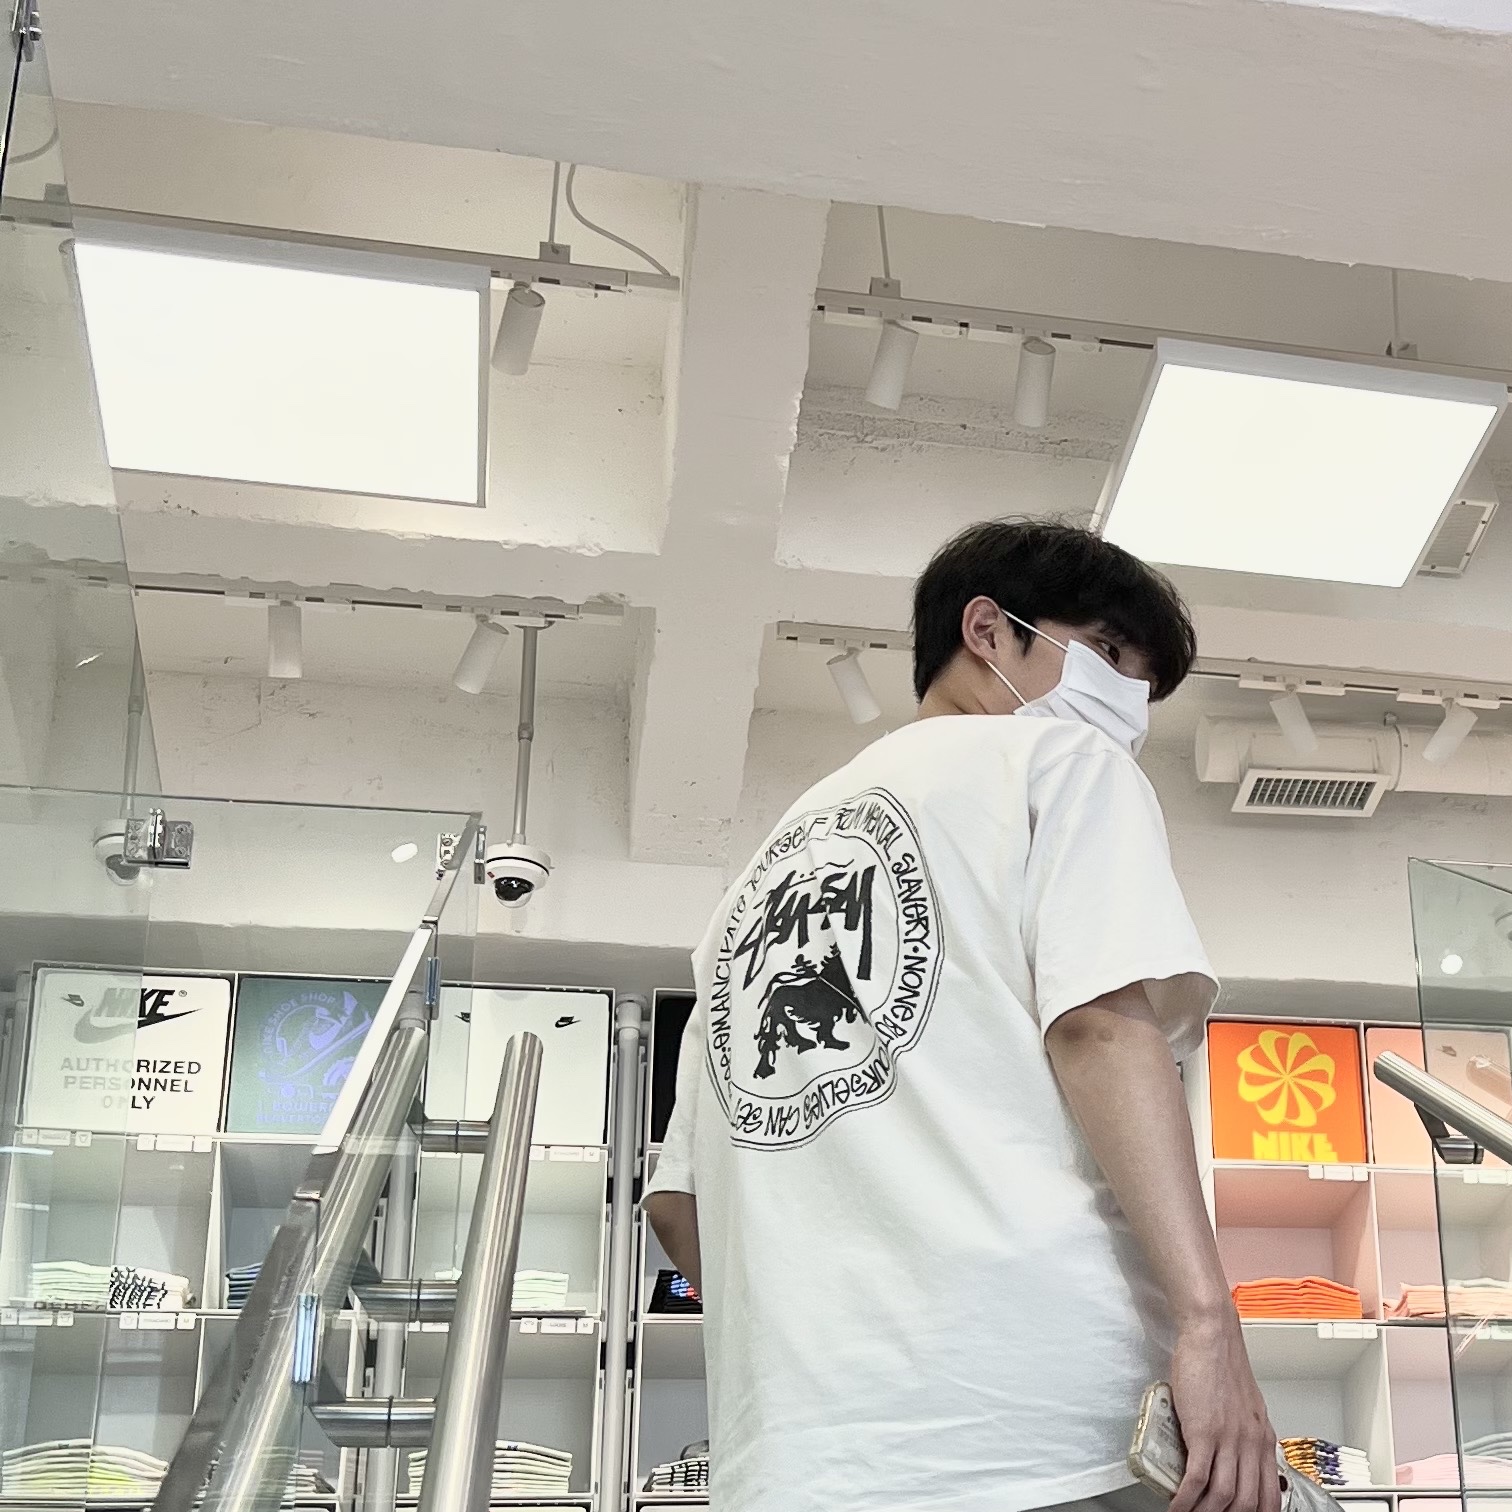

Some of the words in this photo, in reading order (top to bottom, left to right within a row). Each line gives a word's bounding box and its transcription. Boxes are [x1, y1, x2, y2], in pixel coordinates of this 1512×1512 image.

[890, 954, 929, 1022] NONE
[61, 1057, 202, 1075] AUTHORIZED
[63, 1075, 194, 1093] PERSONNEL
[1252, 1130, 1339, 1162] NIKE
